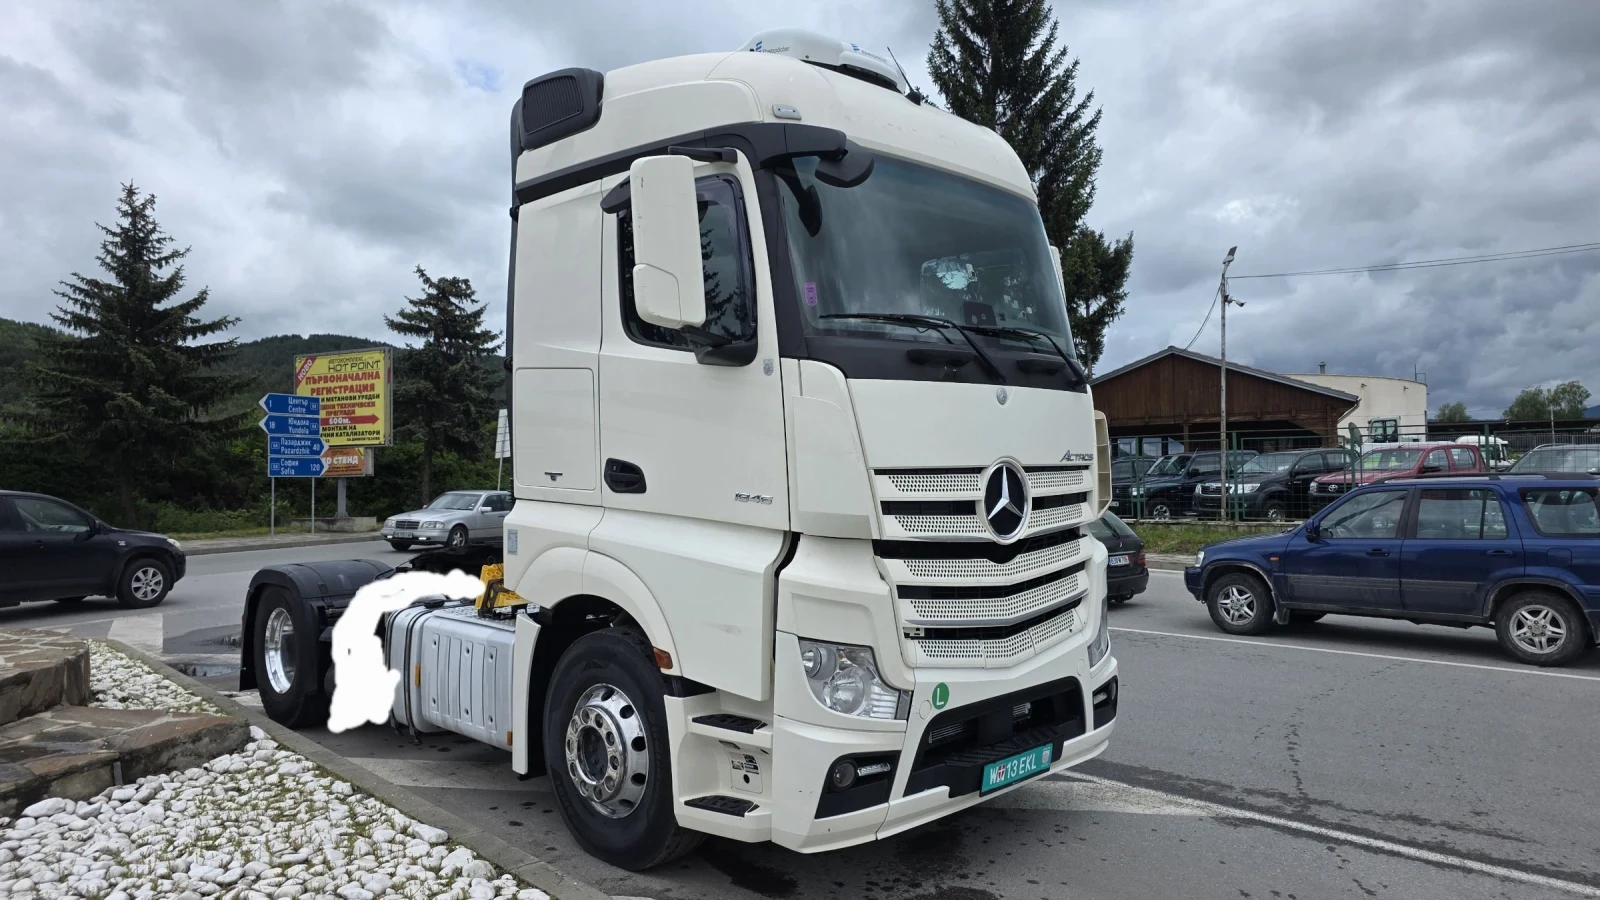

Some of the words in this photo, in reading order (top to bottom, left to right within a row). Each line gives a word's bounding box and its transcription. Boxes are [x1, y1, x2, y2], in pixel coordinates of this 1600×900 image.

[328, 363, 348, 373] HOT
[351, 360, 380, 371] POINT
[305, 371, 380, 385] ПЪРВОНАЧАЛНА
[310, 383, 375, 396] РЕГИСТРАЦИЯ
[288, 397, 308, 407] Център
[288, 405, 306, 413] Centre
[269, 421, 275, 429] 18
[288, 418, 309, 426] Юндола
[288, 426, 309, 434] Yundola
[280, 438, 311, 447] Пазарджик
[280, 459, 299, 467] София
[333, 456, 358, 464] СТЕНД
[280, 467, 295, 475] Sofia
[310, 463, 320, 471] 120
[936, 687, 944, 705] L
